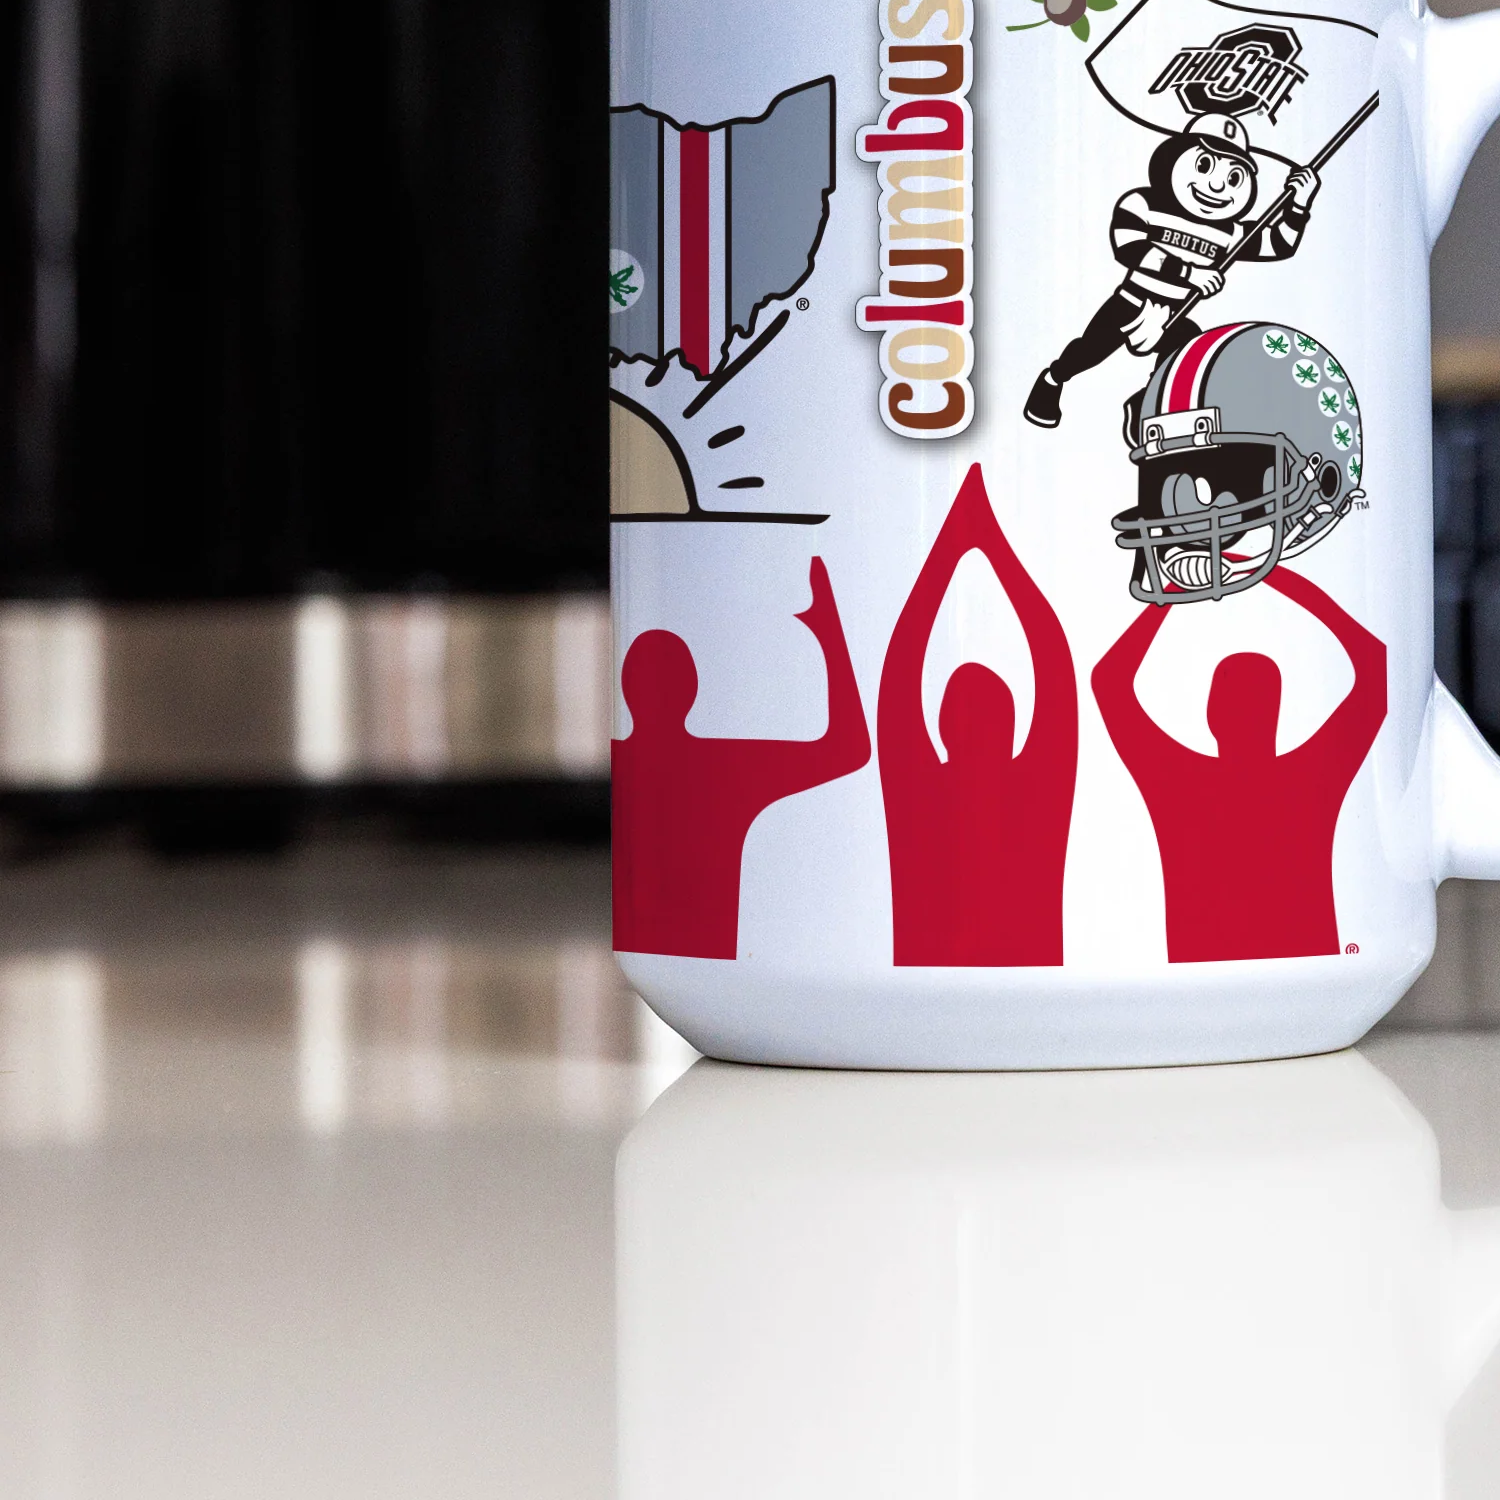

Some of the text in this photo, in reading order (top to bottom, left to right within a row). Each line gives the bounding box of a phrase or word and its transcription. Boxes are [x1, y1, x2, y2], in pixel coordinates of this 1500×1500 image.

[1148, 49, 1306, 127] OHIO STATE
[1161, 229, 1219, 258] BRUTUS
